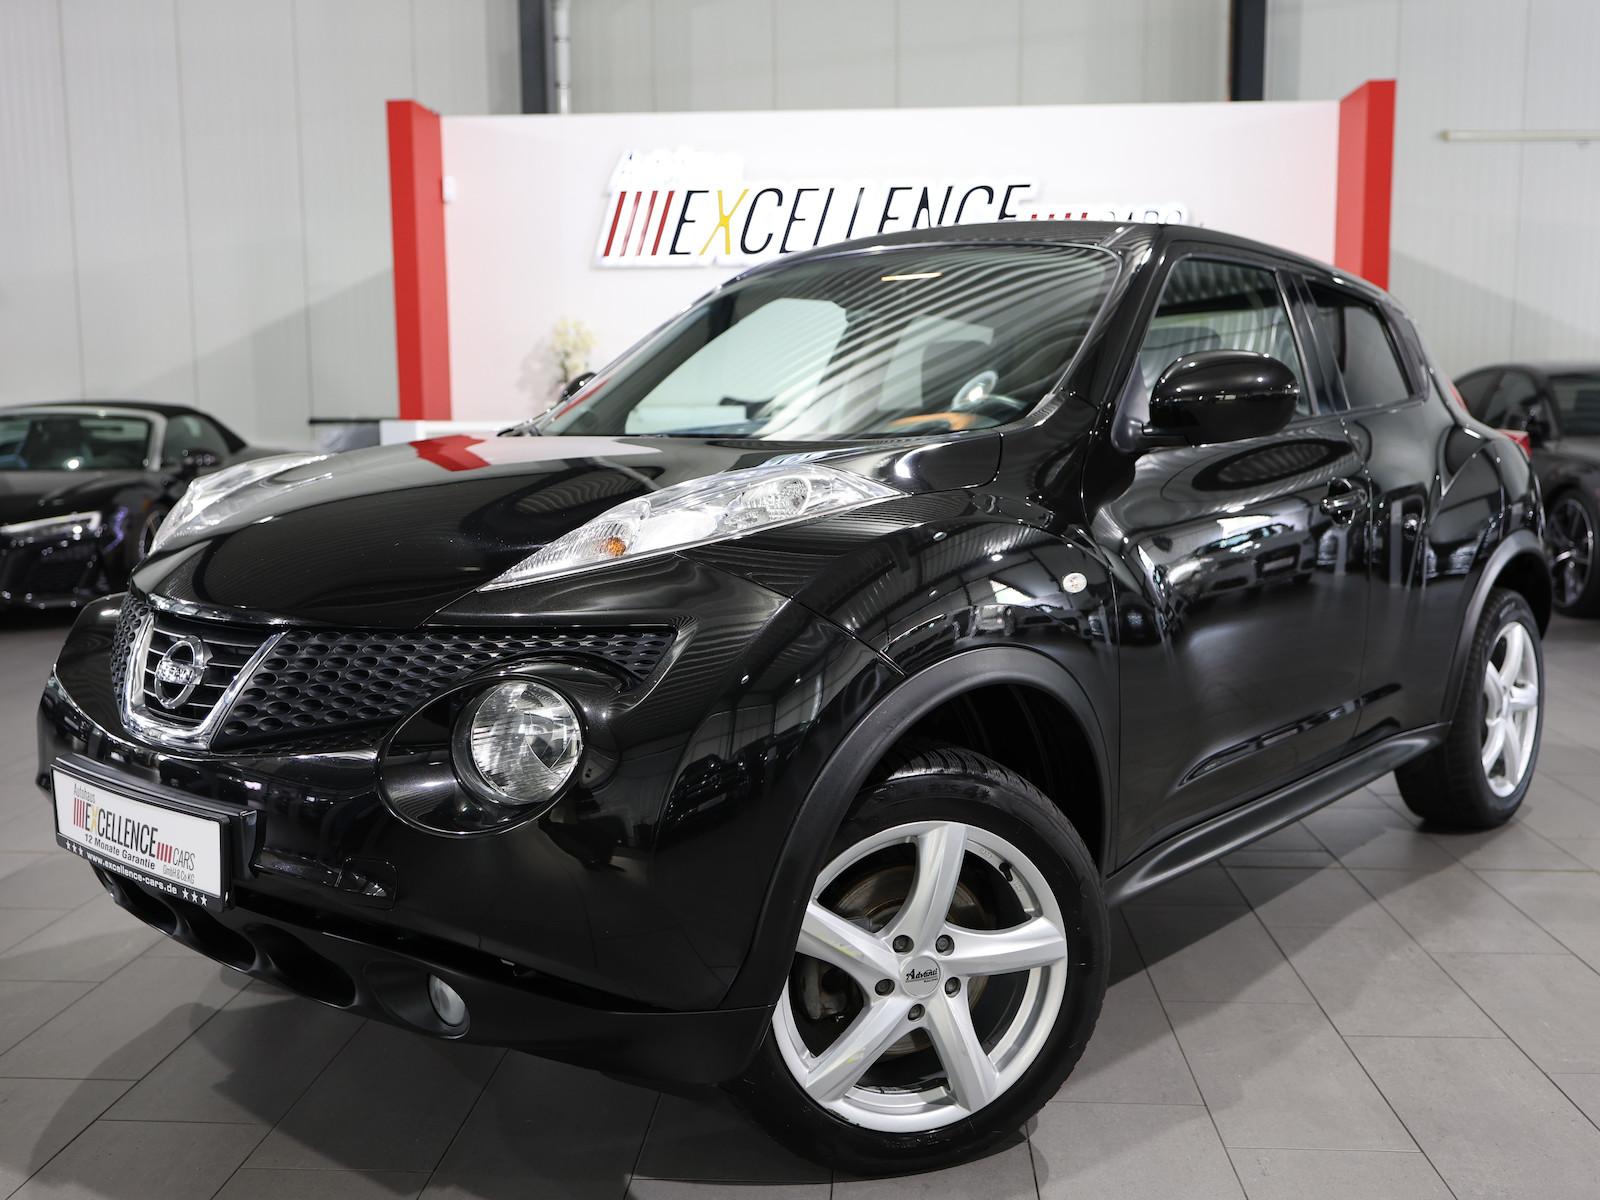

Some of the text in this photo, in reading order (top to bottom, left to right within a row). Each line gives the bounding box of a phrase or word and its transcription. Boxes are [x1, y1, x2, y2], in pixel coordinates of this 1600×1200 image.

[669, 184, 1031, 255] EXCELLENCE
[85, 802, 196, 871] EXCELLENCE CARS
[85, 833, 156, 870] 12 Monate Garantie
[86, 851, 178, 896] www.excellence-cars.de
